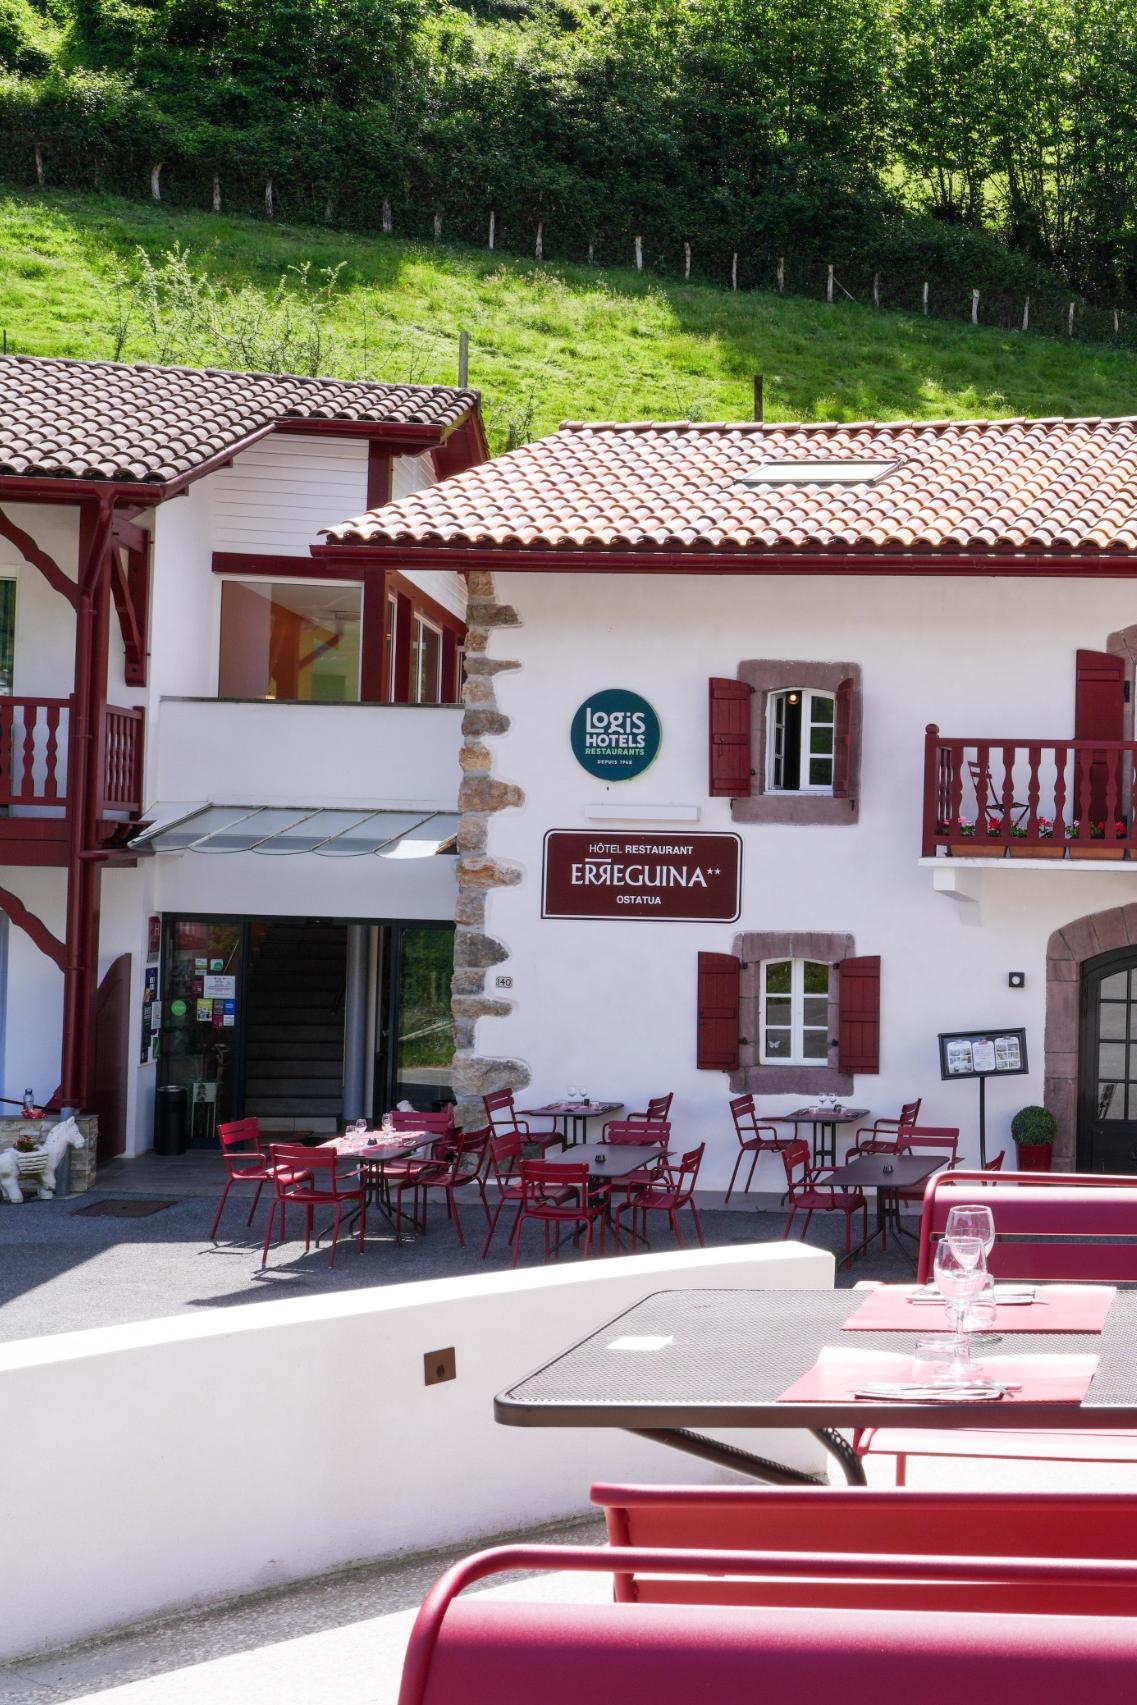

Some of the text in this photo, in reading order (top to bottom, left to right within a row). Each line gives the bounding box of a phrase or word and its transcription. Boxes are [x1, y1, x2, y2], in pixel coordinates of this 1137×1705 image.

[585, 734, 646, 748] HOTELS
[585, 748, 645, 756] RESTAURANTS
[589, 843, 693, 855] HÔTEL RESTAURANT
[616, 895, 662, 905] OSTATUA
